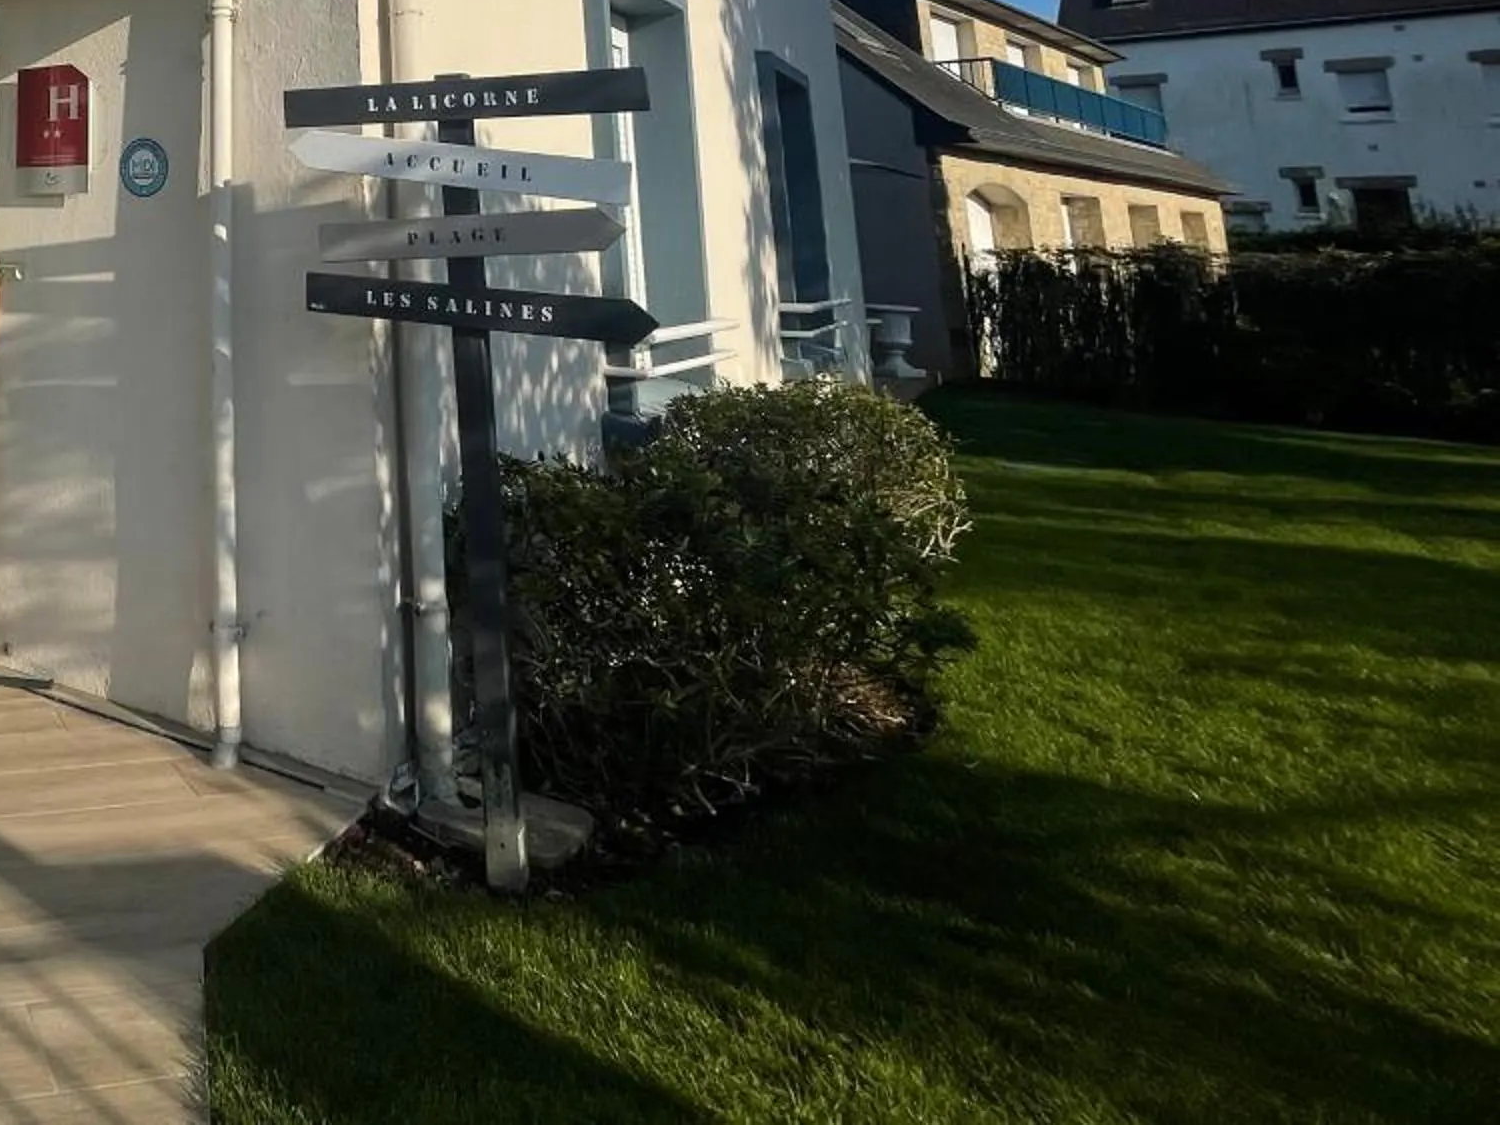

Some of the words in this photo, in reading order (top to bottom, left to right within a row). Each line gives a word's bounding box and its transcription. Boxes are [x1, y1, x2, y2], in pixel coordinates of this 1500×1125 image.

[47, 84, 80, 122] H
[368, 95, 398, 113] LA
[412, 86, 541, 112] LICORNE
[383, 151, 533, 183] ACCUEIL
[407, 226, 508, 246] PLAGE
[366, 289, 413, 309] LES
[426, 295, 555, 323] SALINES
